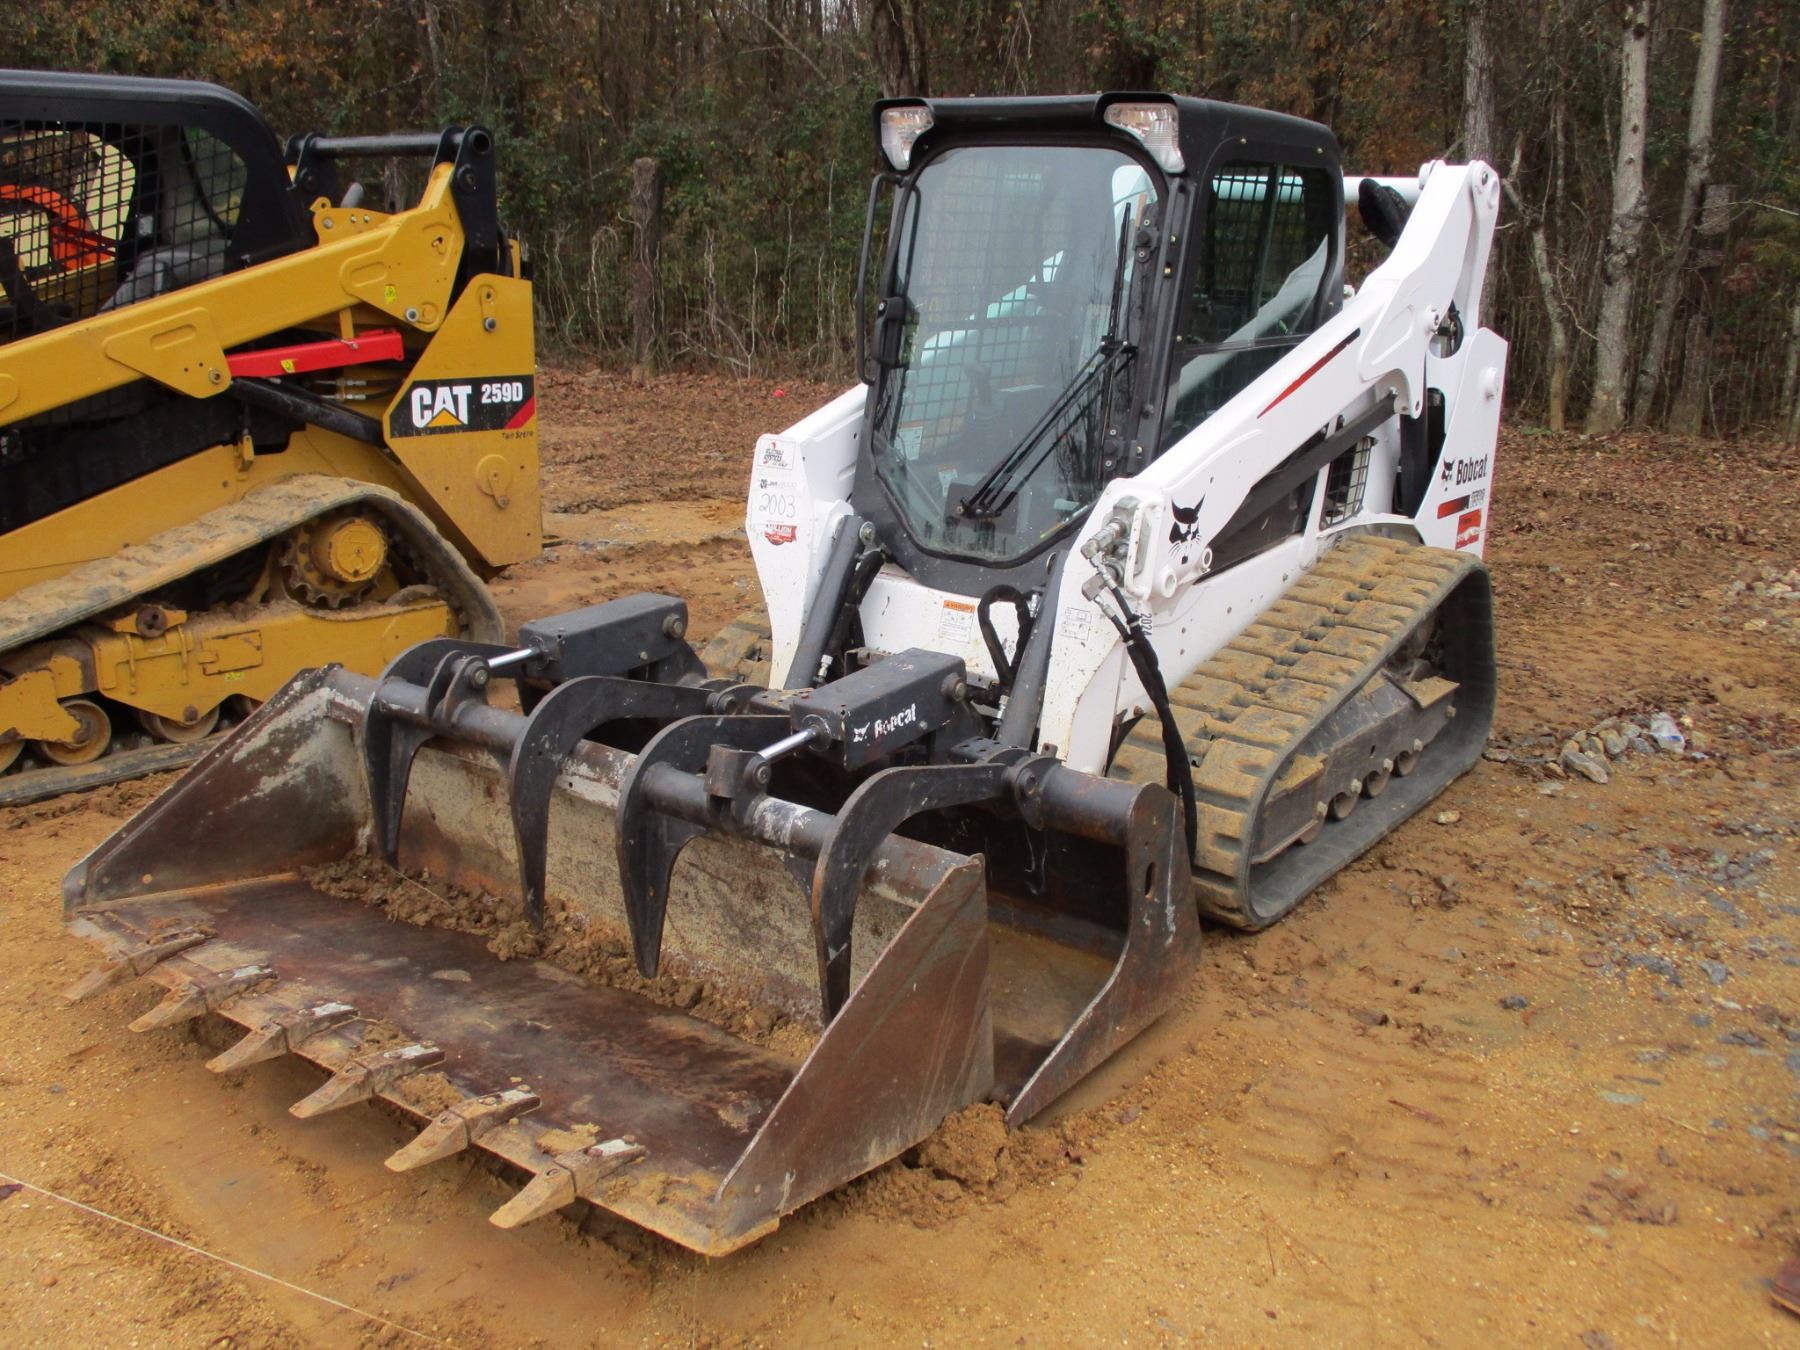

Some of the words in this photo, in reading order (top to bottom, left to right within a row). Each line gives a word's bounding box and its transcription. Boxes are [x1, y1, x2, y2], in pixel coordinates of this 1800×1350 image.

[411, 384, 472, 428] CAT
[481, 382, 523, 404] 259D
[1456, 454, 1488, 486] Bobcat
[759, 493, 796, 518] 2003
